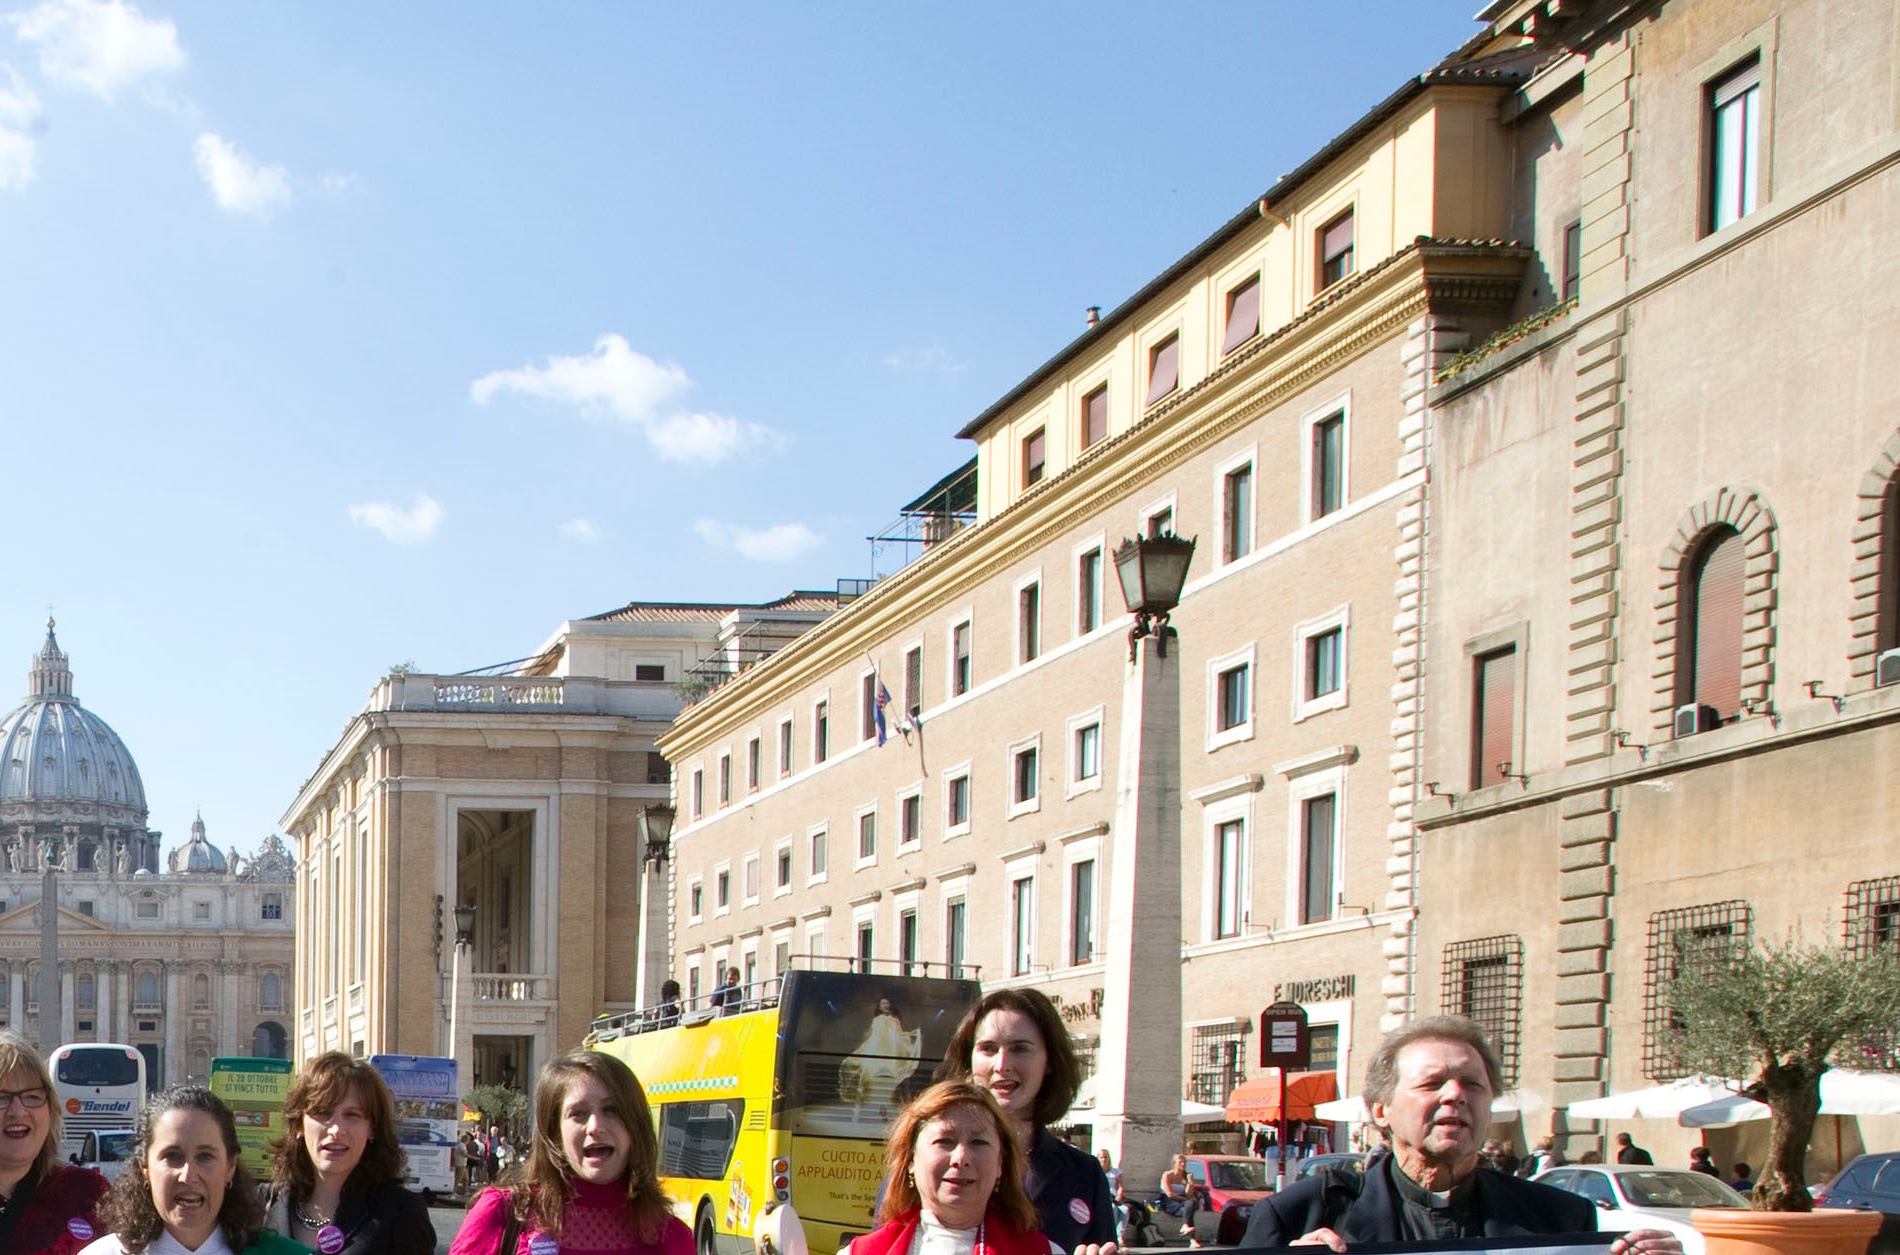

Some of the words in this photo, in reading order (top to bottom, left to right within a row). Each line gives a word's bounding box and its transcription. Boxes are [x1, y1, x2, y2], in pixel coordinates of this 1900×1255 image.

[84, 1100, 132, 1112] Bendel
[822, 1150, 866, 1165] CUCITO
[868, 1154, 877, 1165] A
[798, 1165, 872, 1182] APPLAUDITO
[875, 1170, 883, 1182] A
